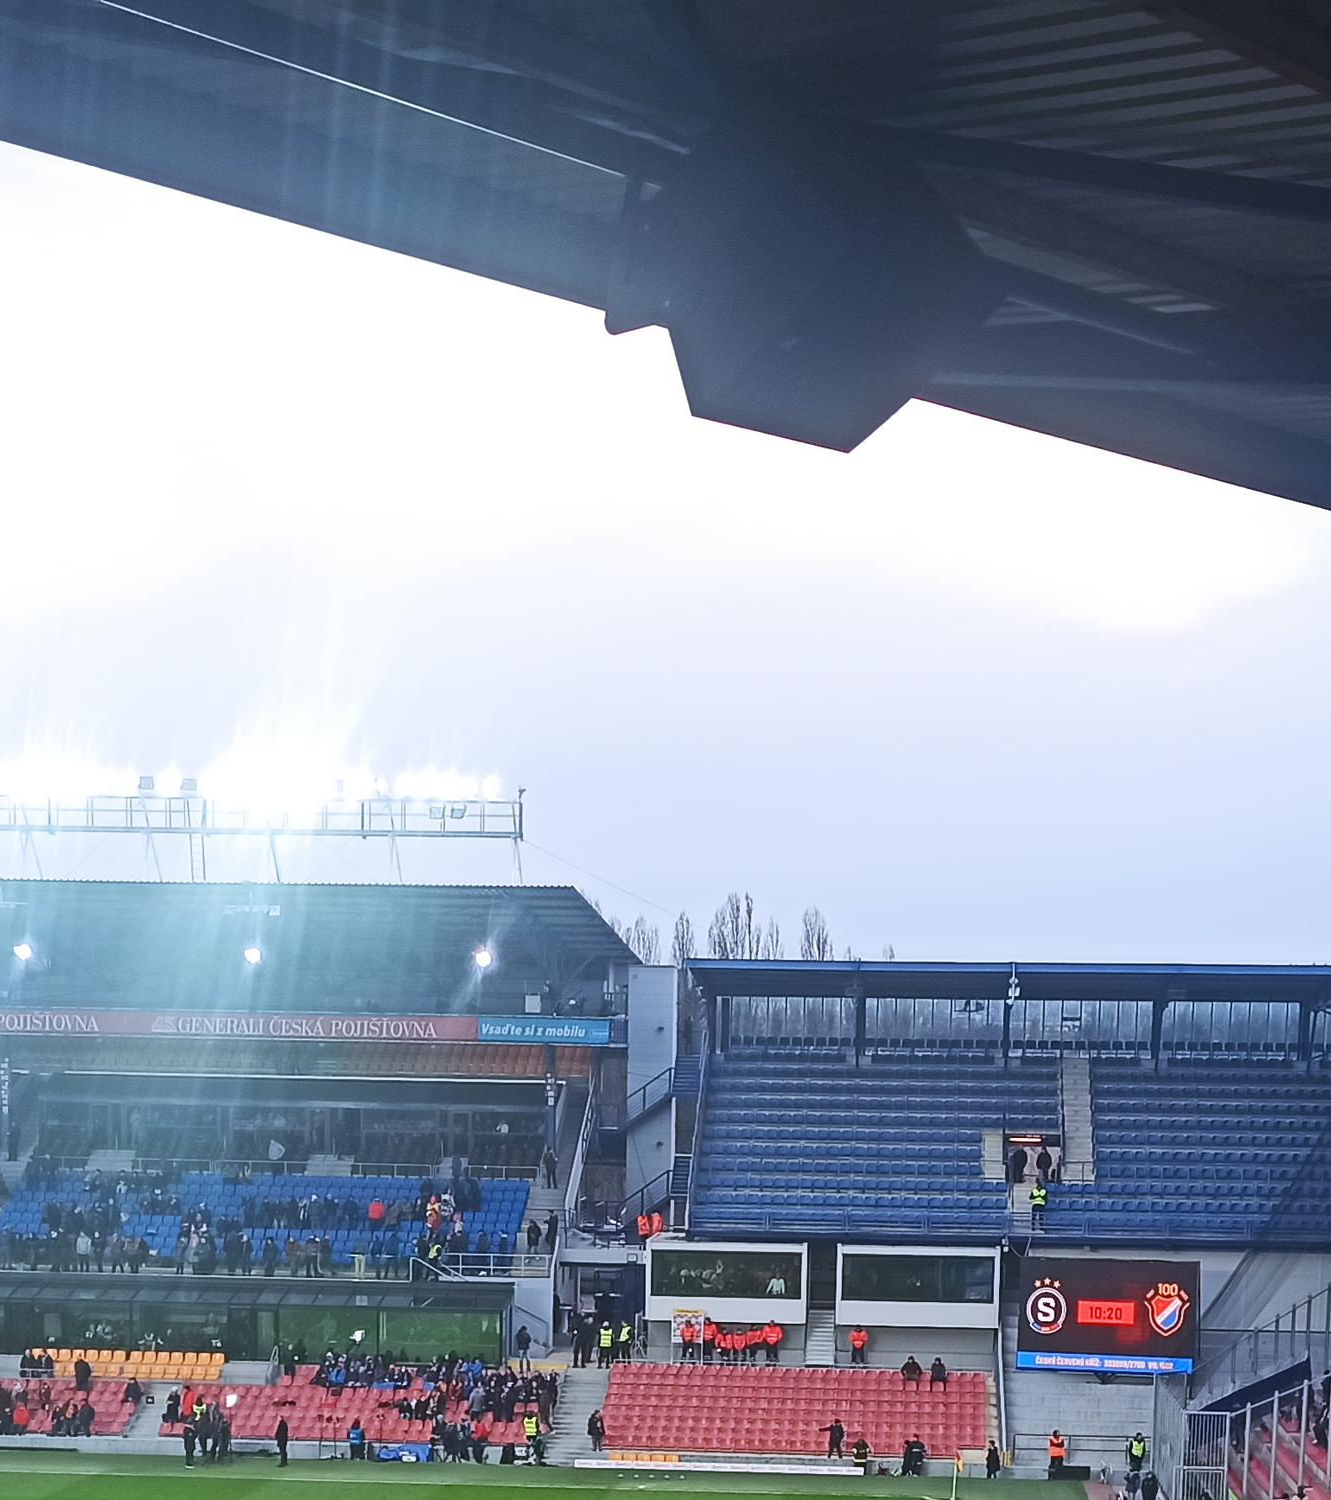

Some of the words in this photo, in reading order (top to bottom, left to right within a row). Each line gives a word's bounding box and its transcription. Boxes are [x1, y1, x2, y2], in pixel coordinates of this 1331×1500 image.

[177, 1016, 265, 1036] GENERALI
[269, 1014, 325, 1037] ČESKÁ
[329, 1016, 438, 1039] POJIŠŤOVNA
[481, 1023, 522, 1036] Vsaďte
[523, 1024, 535, 1037] si
[545, 1025, 586, 1038] mobilu
[1157, 1283, 1179, 1296] 100
[1037, 1296, 1056, 1322] S
[1088, 1306, 1123, 1321] 10:20
